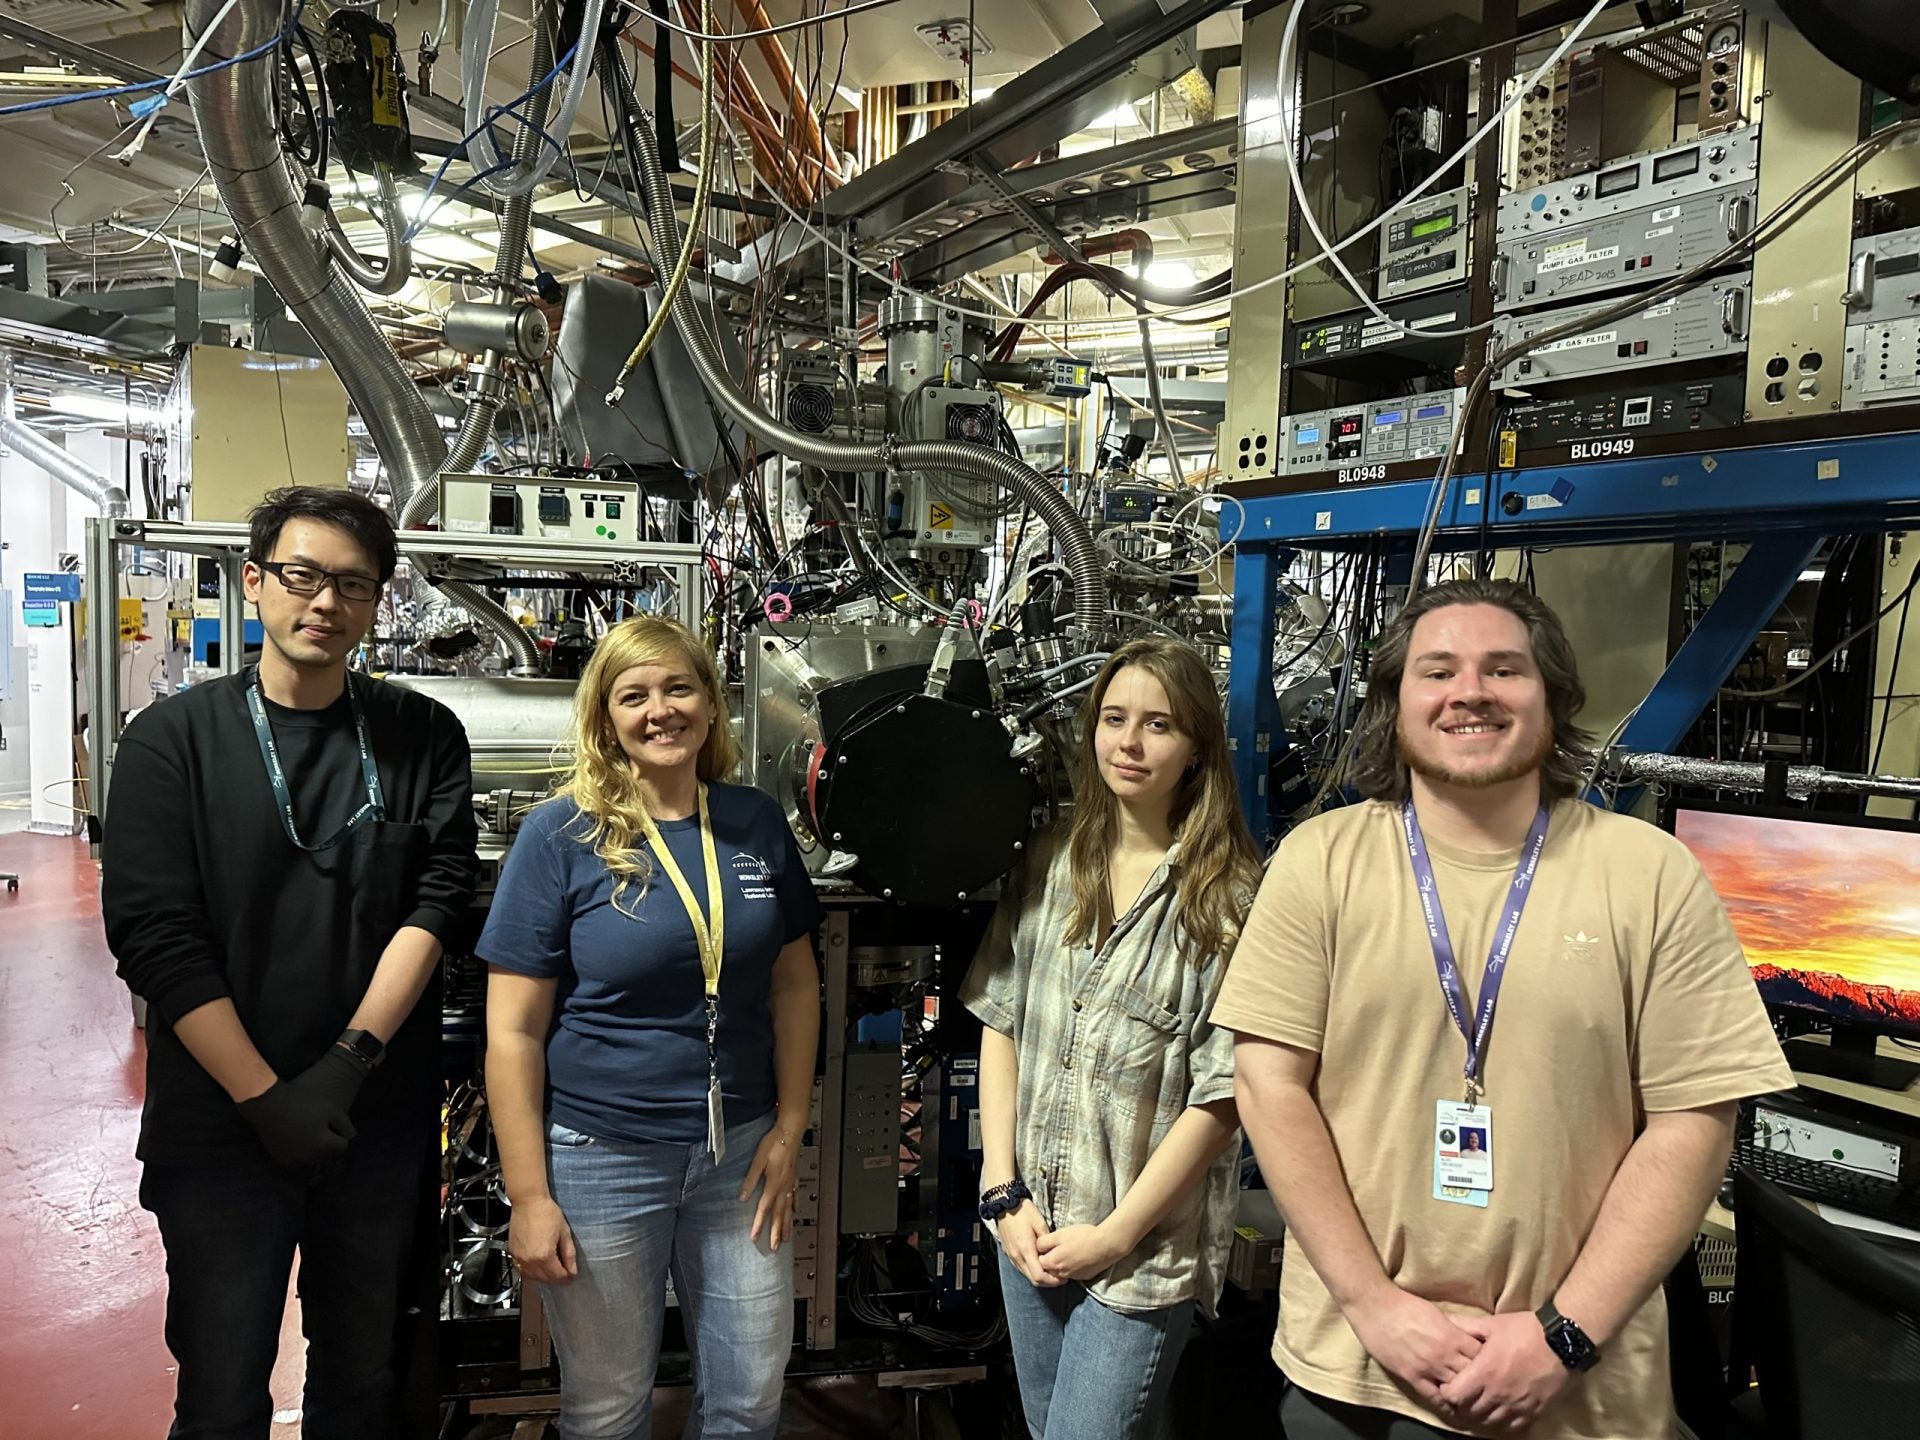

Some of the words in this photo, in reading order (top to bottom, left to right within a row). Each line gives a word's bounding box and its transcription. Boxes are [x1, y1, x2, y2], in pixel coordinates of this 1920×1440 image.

[387, 74, 398, 116] NITROGEN
[1542, 260, 1563, 271] PUMP1
[1568, 256, 1584, 265] GAS
[1588, 249, 1613, 259] FILTER
[1558, 270, 1594, 289] DEAD
[1586, 334, 1611, 344] FILTER
[1571, 438, 1634, 459] BL0949
[1338, 465, 1386, 483] BL0948
[1526, 846, 1540, 875] BERKELEY
[1536, 835, 1544, 847] LAB
[1422, 892, 1434, 923] BERKELEY
[1429, 924, 1438, 937] LAB
[1500, 923, 1516, 956] BERKELEY
[1510, 911, 1520, 924] LAB
[1475, 1014, 1489, 1047] BERKELEY
[1485, 998, 1493, 1014] LAB
